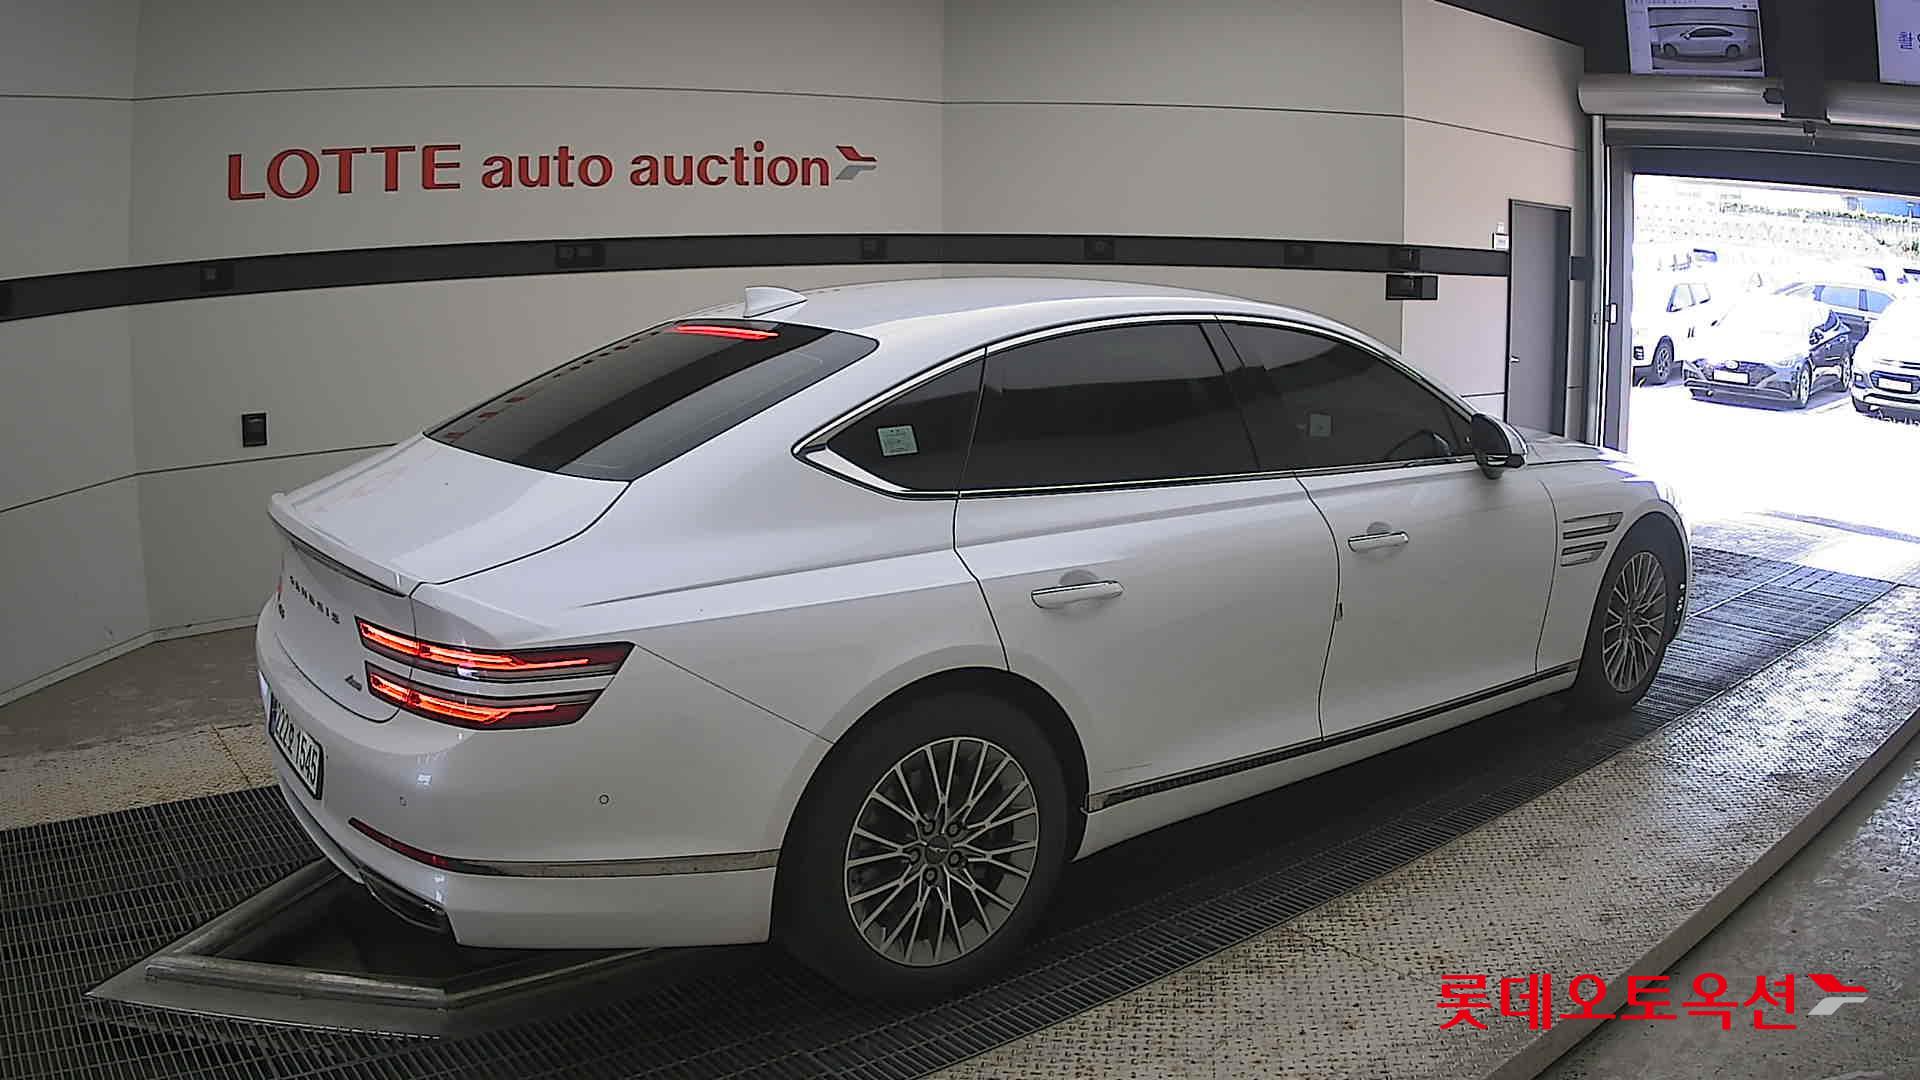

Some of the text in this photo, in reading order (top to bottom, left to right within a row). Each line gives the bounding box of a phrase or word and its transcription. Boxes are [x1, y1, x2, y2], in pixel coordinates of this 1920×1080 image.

[228, 143, 830, 199] LOTTE auto auction
[296, 731, 318, 785] 1545
